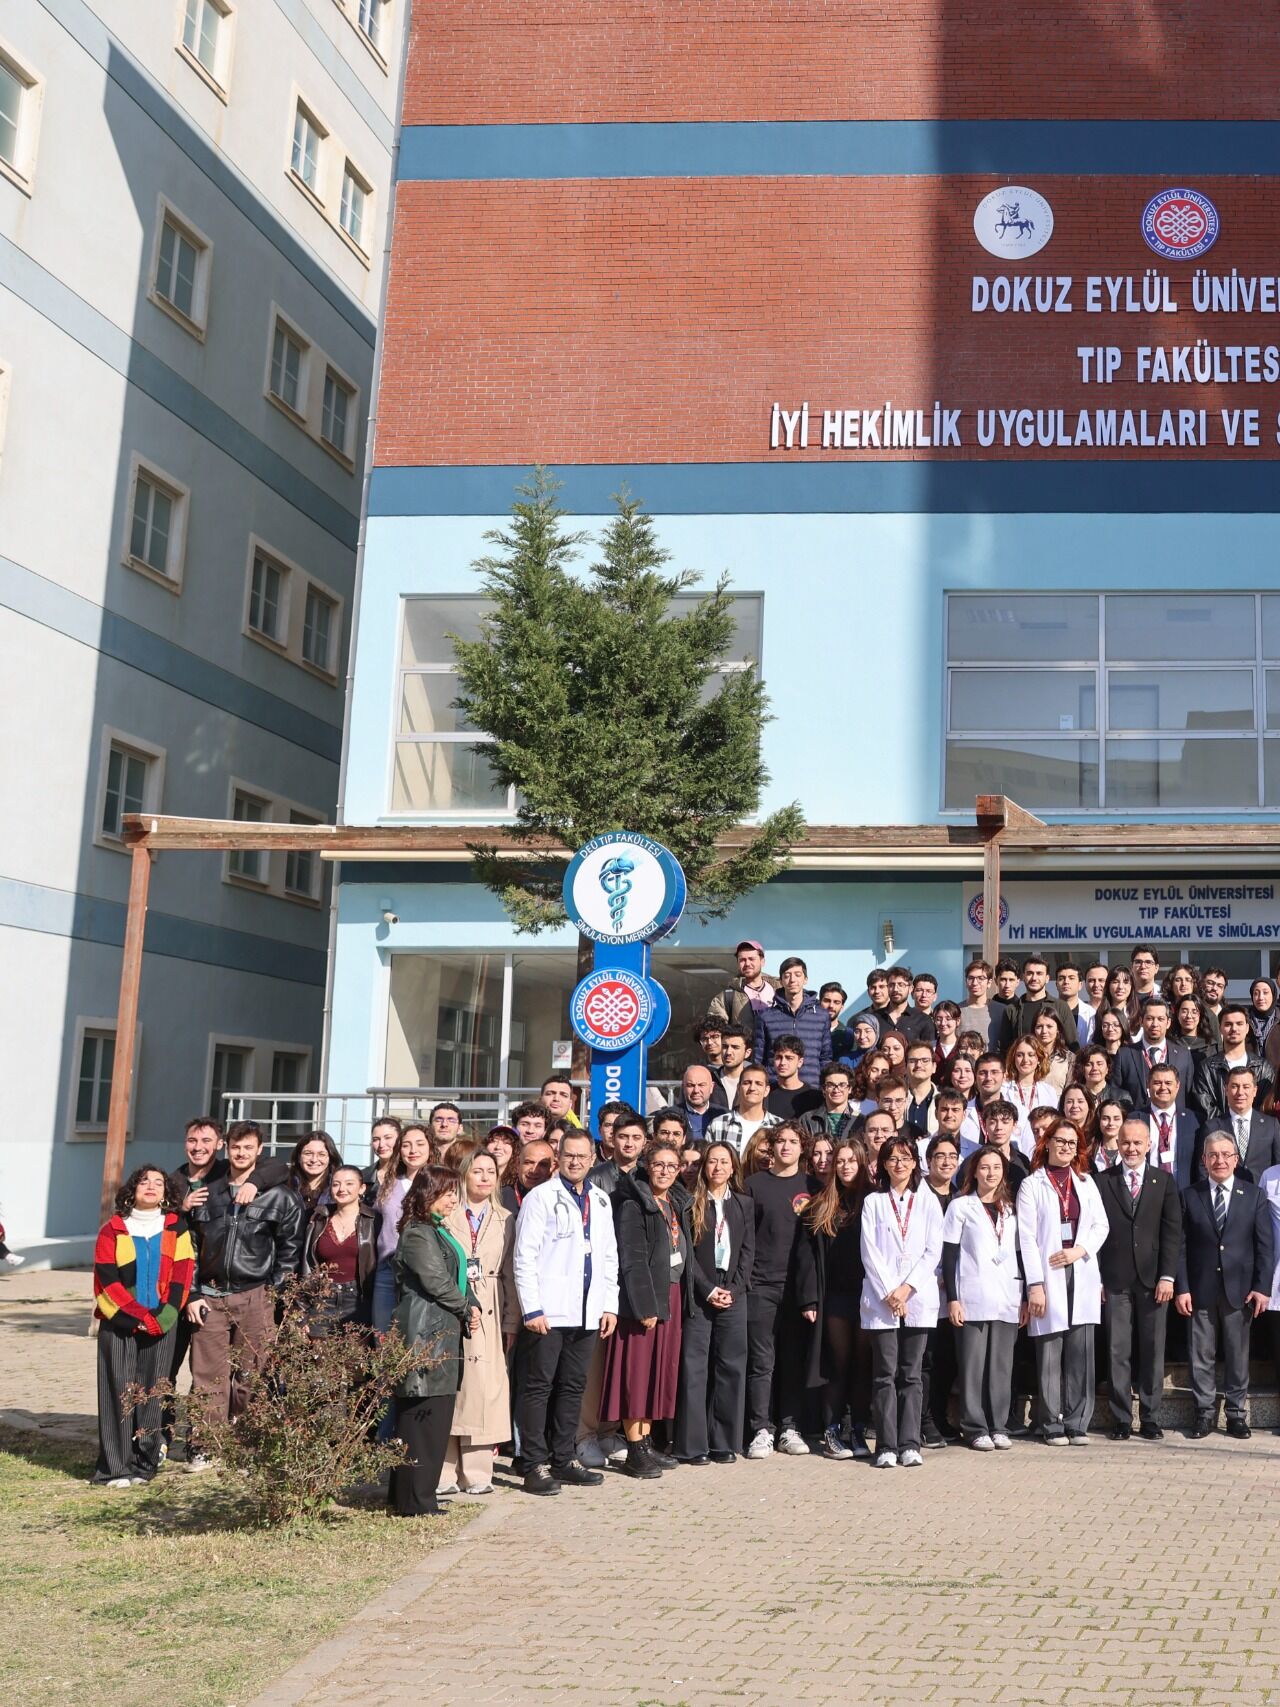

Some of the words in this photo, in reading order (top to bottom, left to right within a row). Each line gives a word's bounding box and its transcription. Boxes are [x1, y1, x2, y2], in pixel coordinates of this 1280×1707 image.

[1145, 203, 1159, 232] DOKUZ
[1157, 190, 1182, 205] EYLÜL
[1154, 240, 1166, 250] TIP
[1165, 242, 1205, 257] FAKÜLTESİ
[972, 275, 1073, 313] DOKUZ
[1086, 269, 1178, 313] EYLÜL
[1077, 346, 1122, 383] TIP
[771, 402, 809, 448] İYİ
[823, 401, 962, 447] HEKİMLİK
[977, 409, 1207, 447] UYGULAMALARI
[1221, 409, 1260, 446] VE
[579, 840, 599, 859] DEÜ
[599, 833, 614, 846] TIP
[616, 833, 663, 858] FAKÜLTESİ
[1095, 888, 1139, 901] DOKUZ
[1143, 885, 1184, 901] EYLÜL
[1188, 885, 1275, 900] ÜNİVERSİTESİ
[1139, 907, 1159, 919] TIP
[1164, 904, 1231, 919] FAKÜLTESİ
[574, 918, 625, 945] SİMÜLASYON
[625, 920, 659, 943] MERKEZİ
[1008, 924, 1025, 939] İYİ
[1029, 924, 1088, 939] HEKİMLİK
[1093, 925, 1191, 939] UYGULAMALARI
[1196, 925, 1213, 938] VE
[575, 986, 591, 1020] DOKUZ
[588, 971, 615, 988] EYLÜL
[615, 971, 649, 1021] ÜNİVERSİTESİ
[583, 1029, 596, 1040] TIP
[595, 1030, 637, 1048] FAKÜLTESİ
[605, 1065, 621, 1105] DOK
